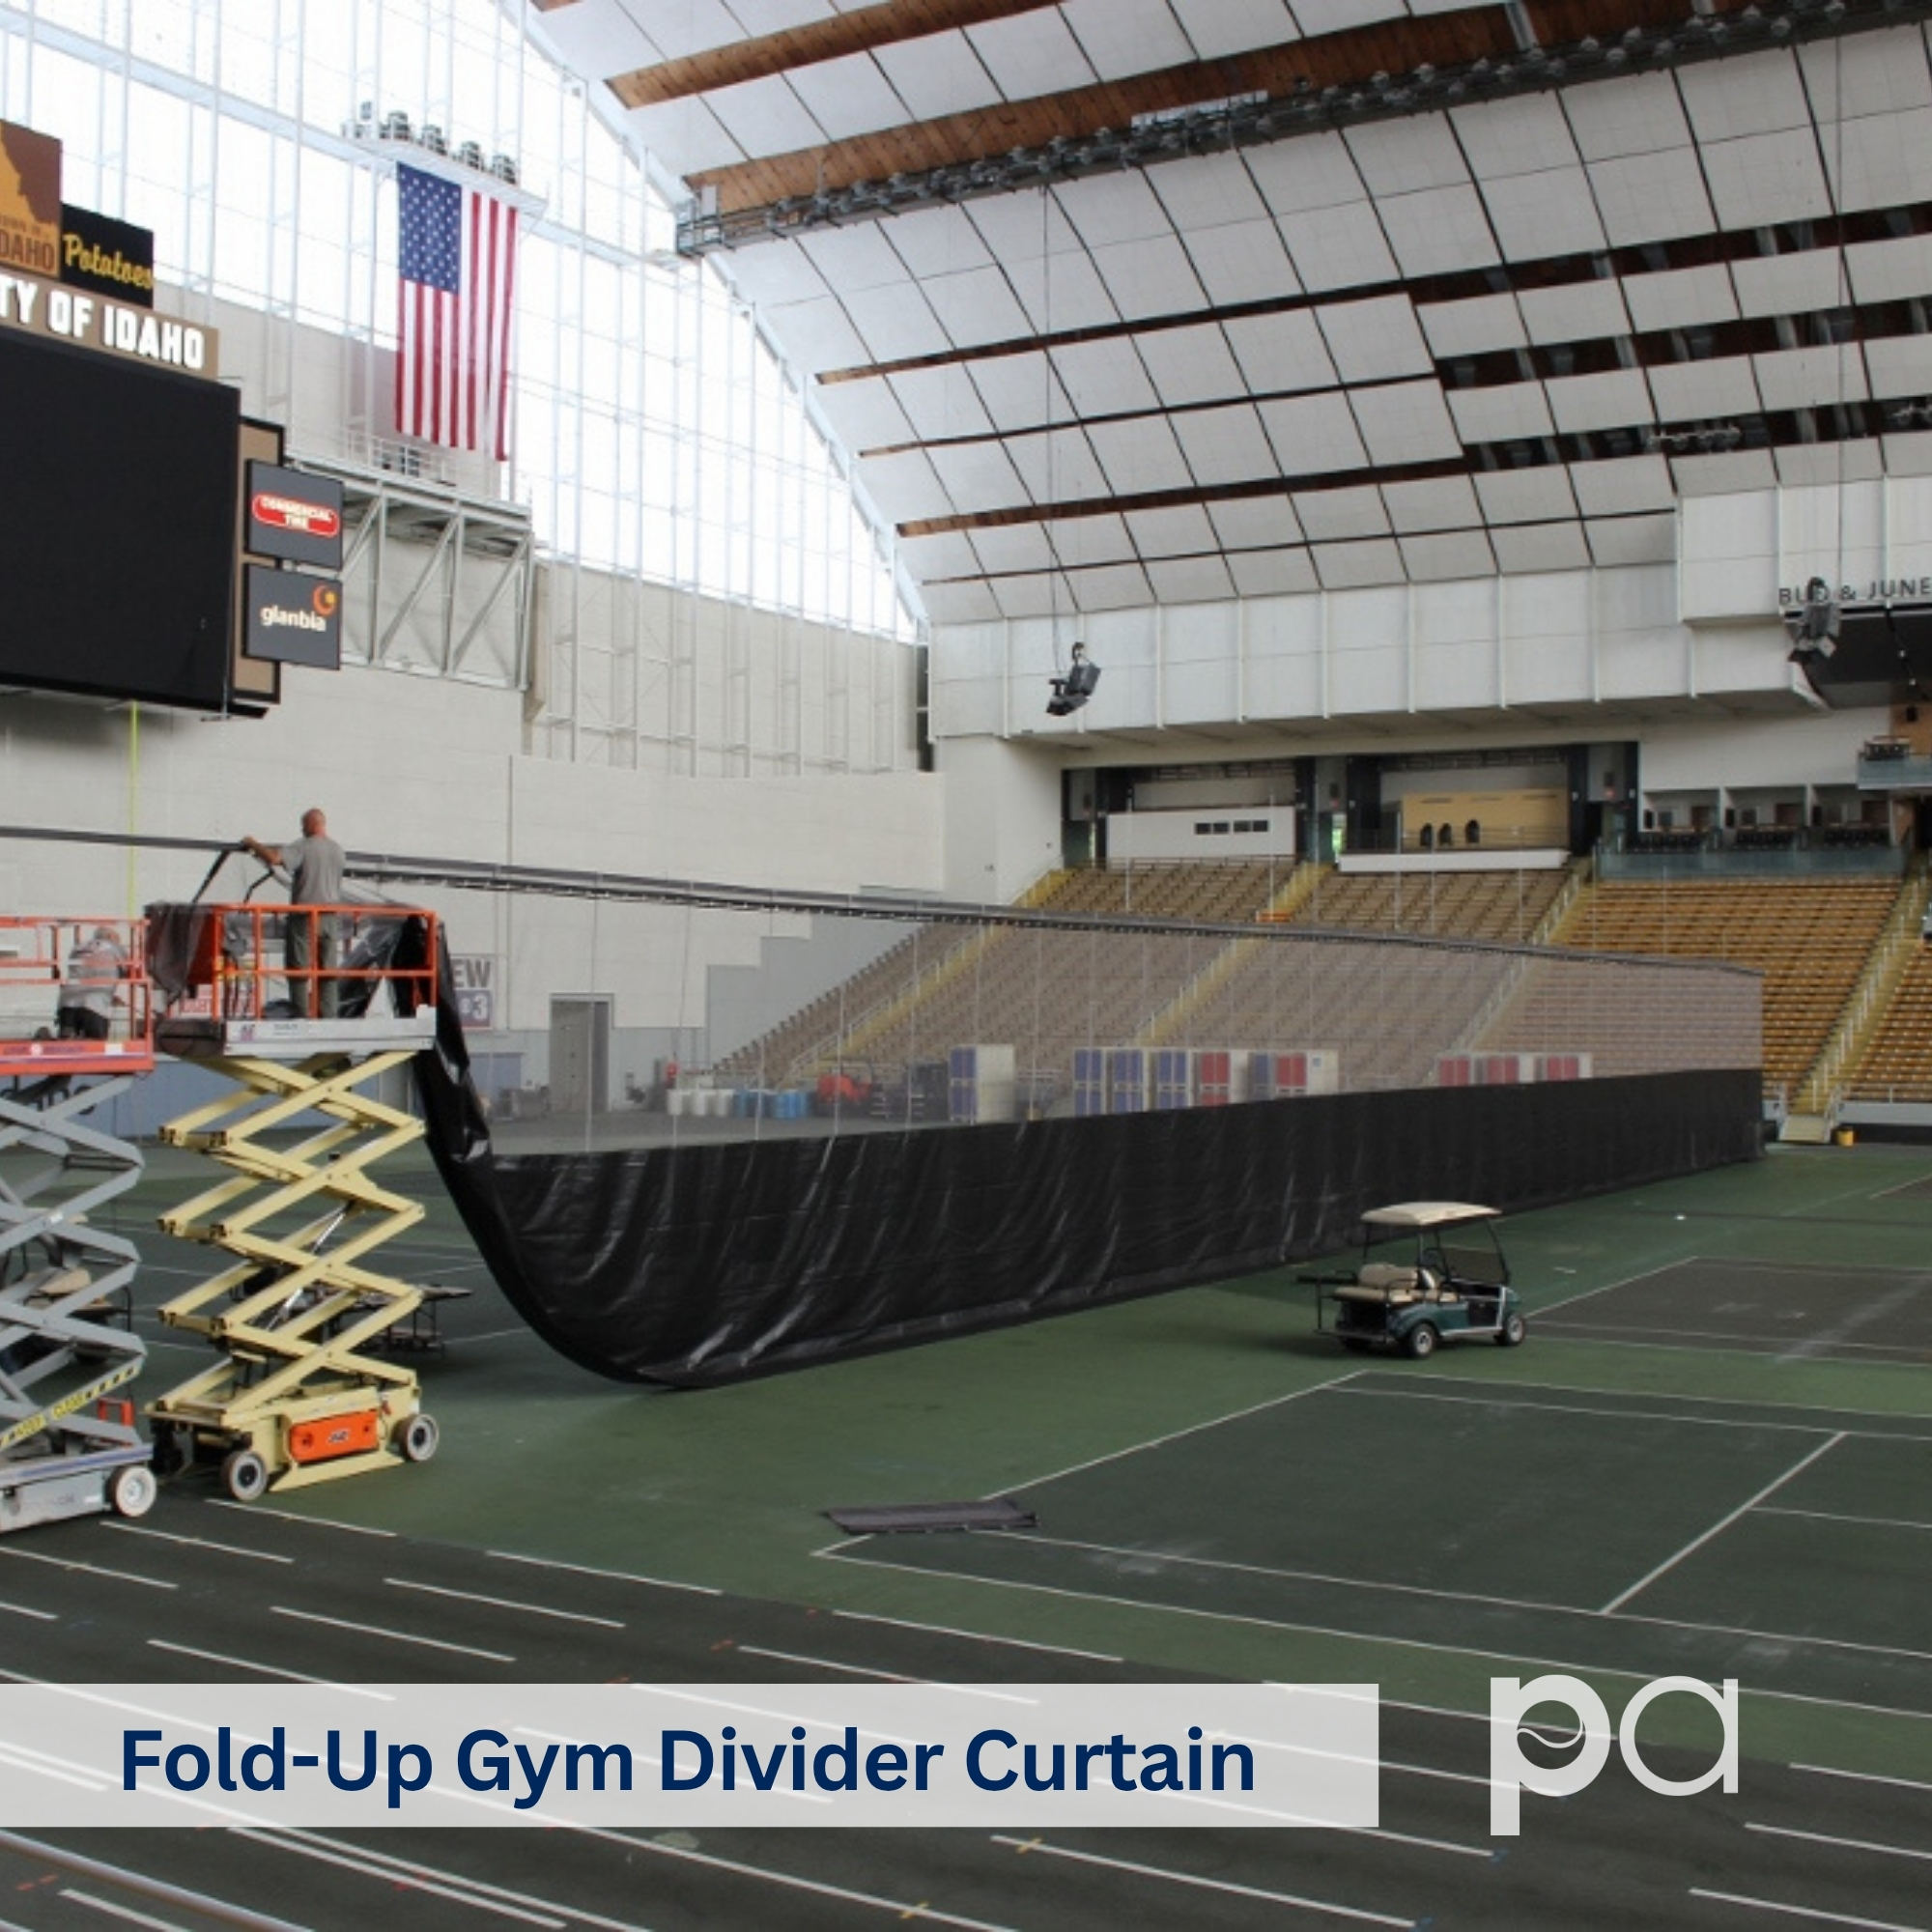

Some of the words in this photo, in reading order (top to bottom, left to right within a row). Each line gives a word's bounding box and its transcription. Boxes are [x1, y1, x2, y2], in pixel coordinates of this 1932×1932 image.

[63, 233, 153, 290] Potatoes
[50, 290, 93, 338] OF
[103, 304, 204, 370] IDAHO
[1840, 585, 1857, 600] &
[1869, 578, 1932, 600] JUNE
[260, 605, 327, 633] glanbia
